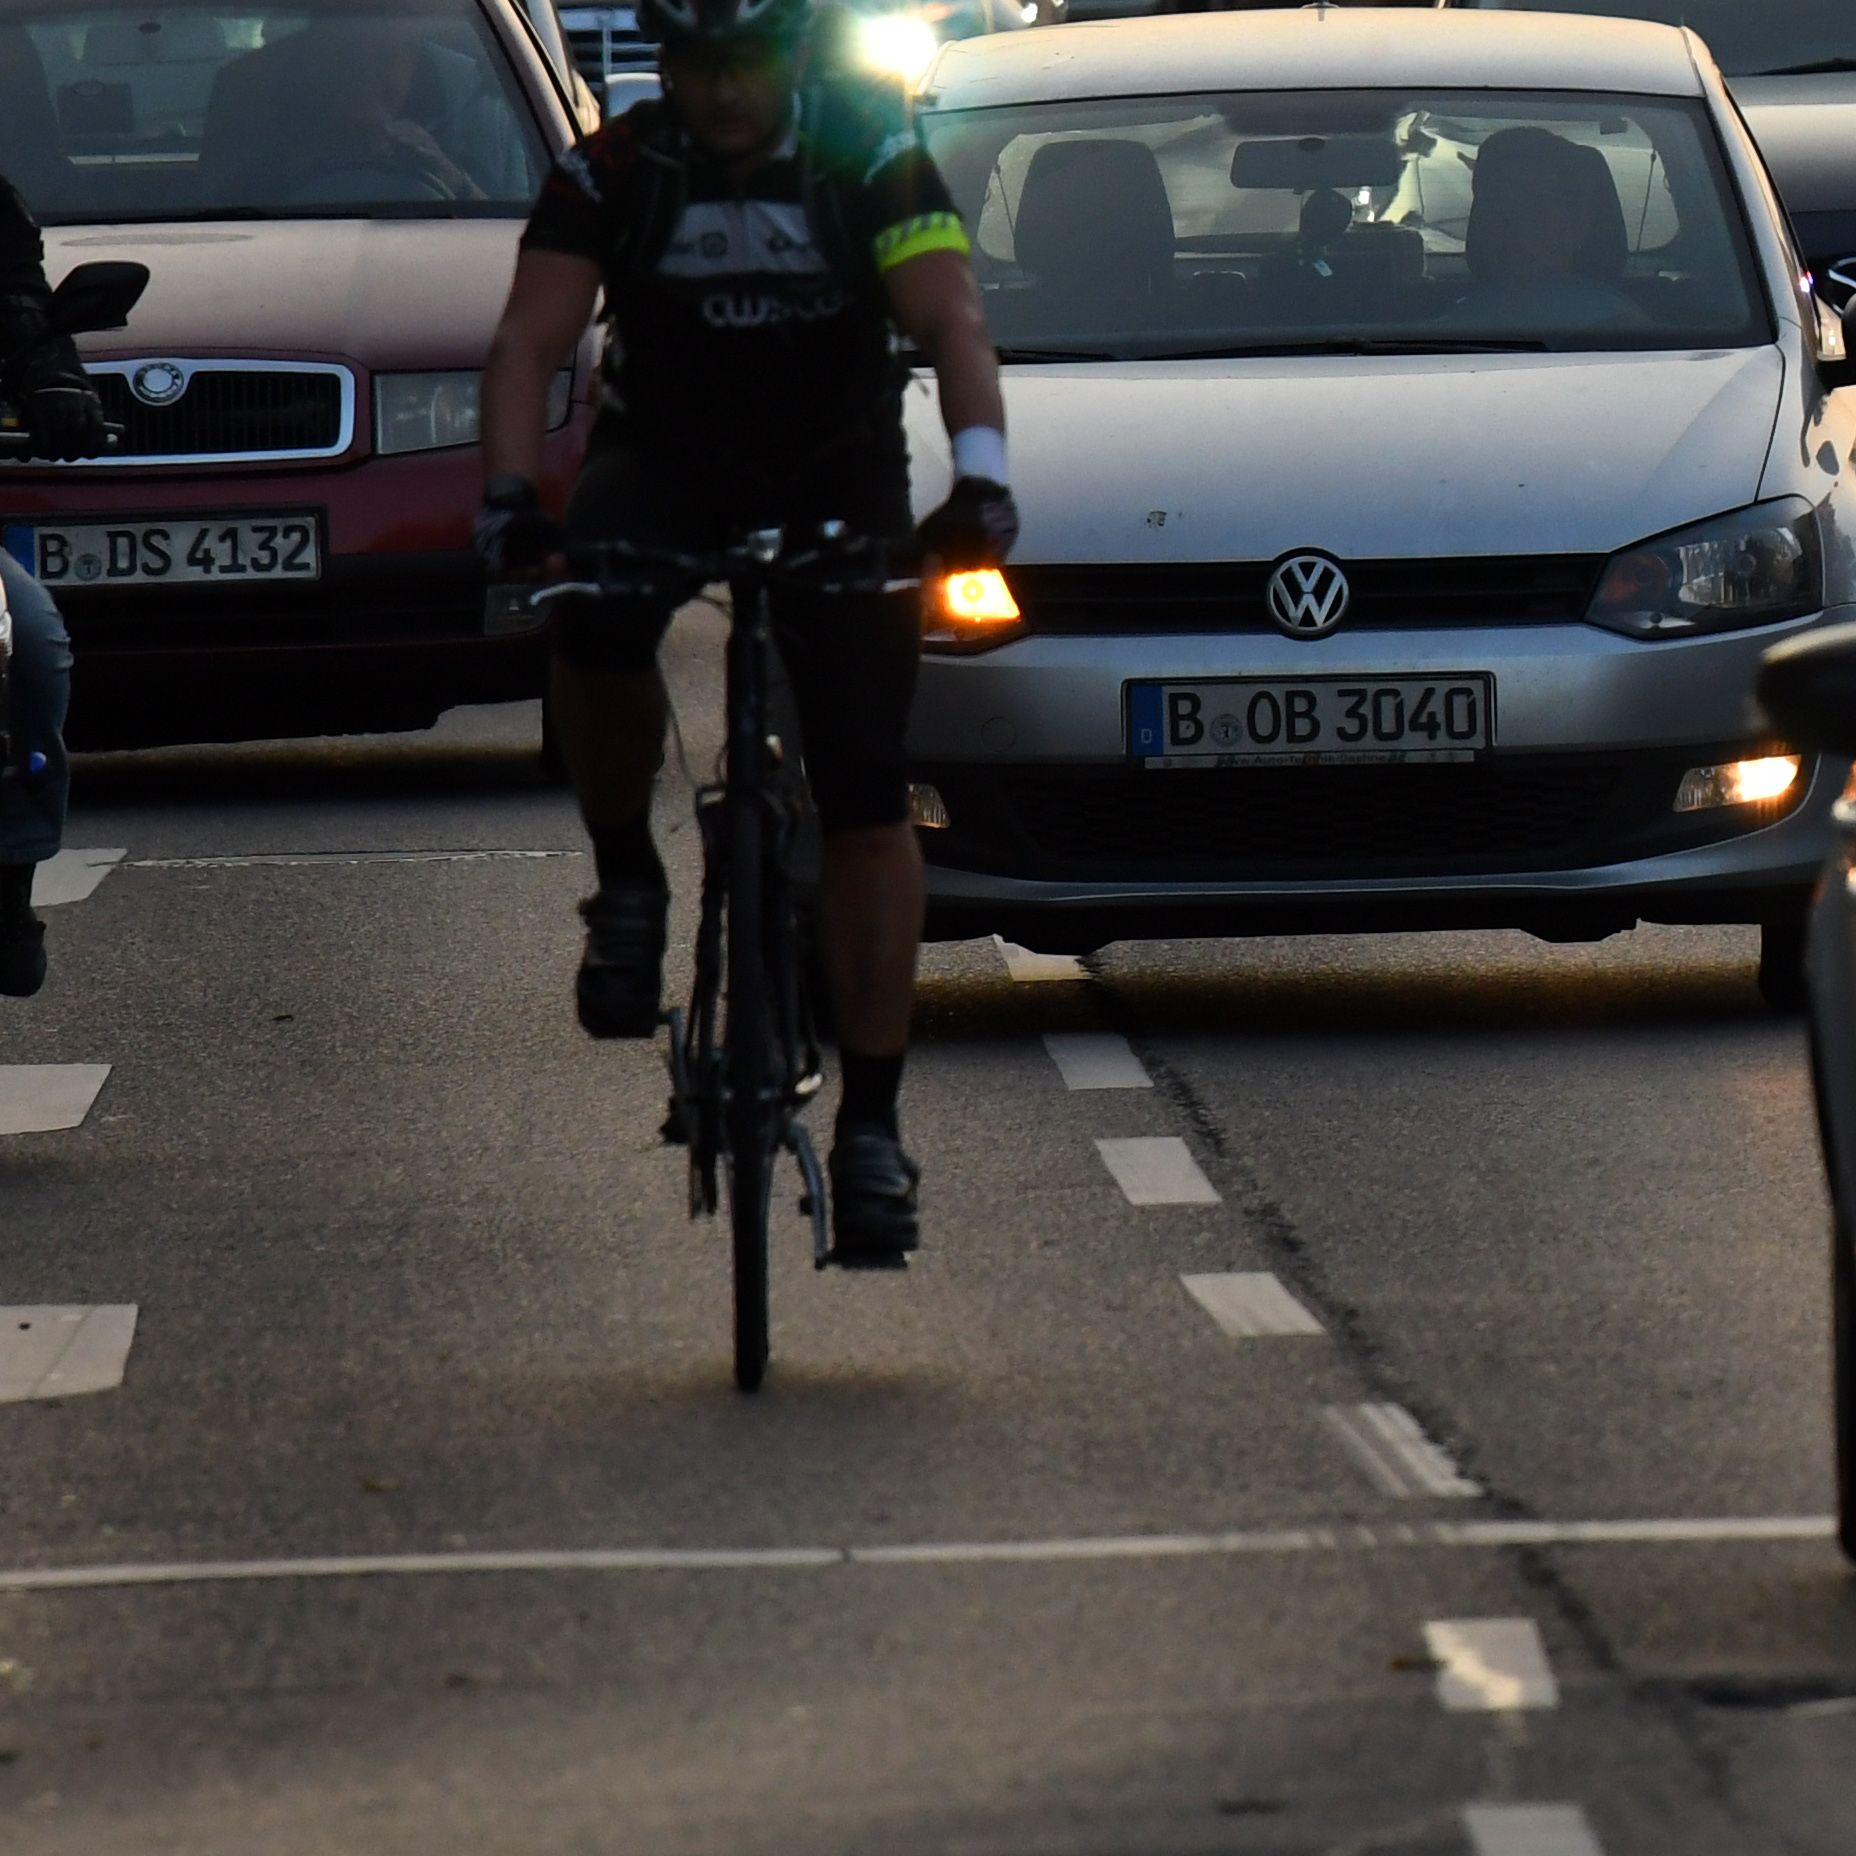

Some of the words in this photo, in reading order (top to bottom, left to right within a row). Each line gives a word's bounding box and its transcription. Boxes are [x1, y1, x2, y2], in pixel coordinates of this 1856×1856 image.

[39, 532, 71, 581] B
[106, 527, 173, 578] DS
[186, 524, 311, 575] 4132
[1168, 691, 1205, 747] B
[1246, 689, 1321, 744] OB
[1335, 686, 1478, 744] 3040
